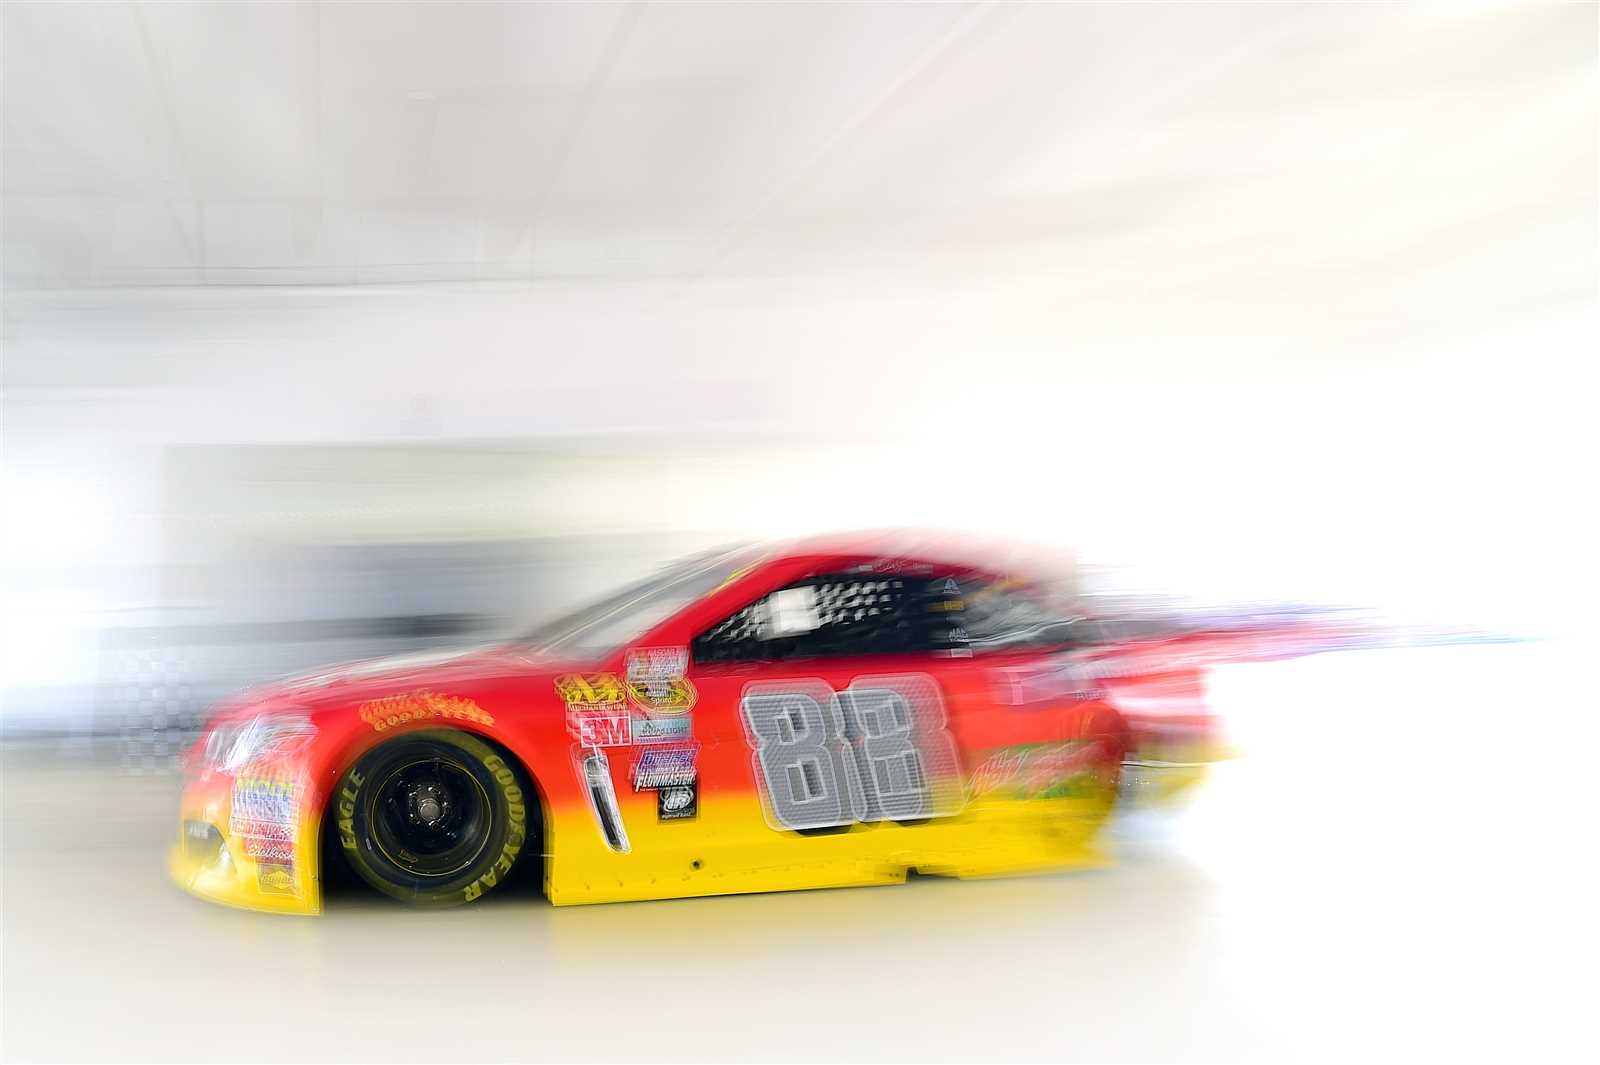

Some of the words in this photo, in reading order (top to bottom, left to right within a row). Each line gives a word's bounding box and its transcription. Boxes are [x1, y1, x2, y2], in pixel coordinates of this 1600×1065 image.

[582, 718, 629, 745] 3M
[740, 673, 965, 832] 88
[341, 768, 366, 849] EAGLE
